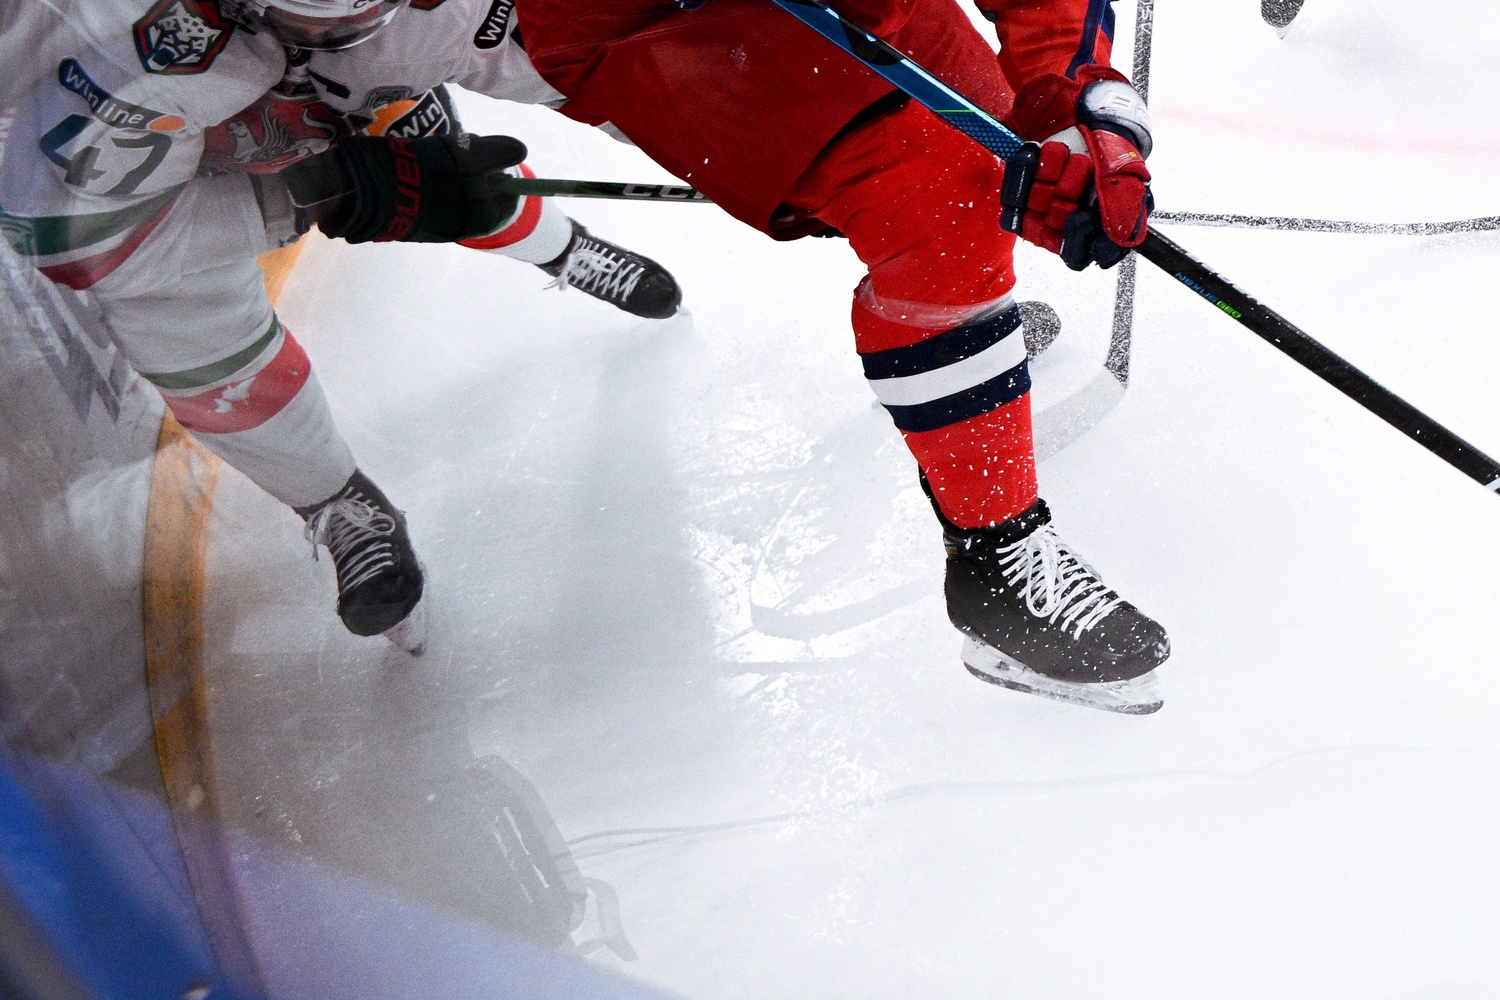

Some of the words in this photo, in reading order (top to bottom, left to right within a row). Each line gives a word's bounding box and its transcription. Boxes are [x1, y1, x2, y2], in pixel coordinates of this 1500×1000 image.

[64, 63, 145, 128] Winline
[39, 113, 177, 196] 47
[1174, 271, 1219, 304] NEXUS
